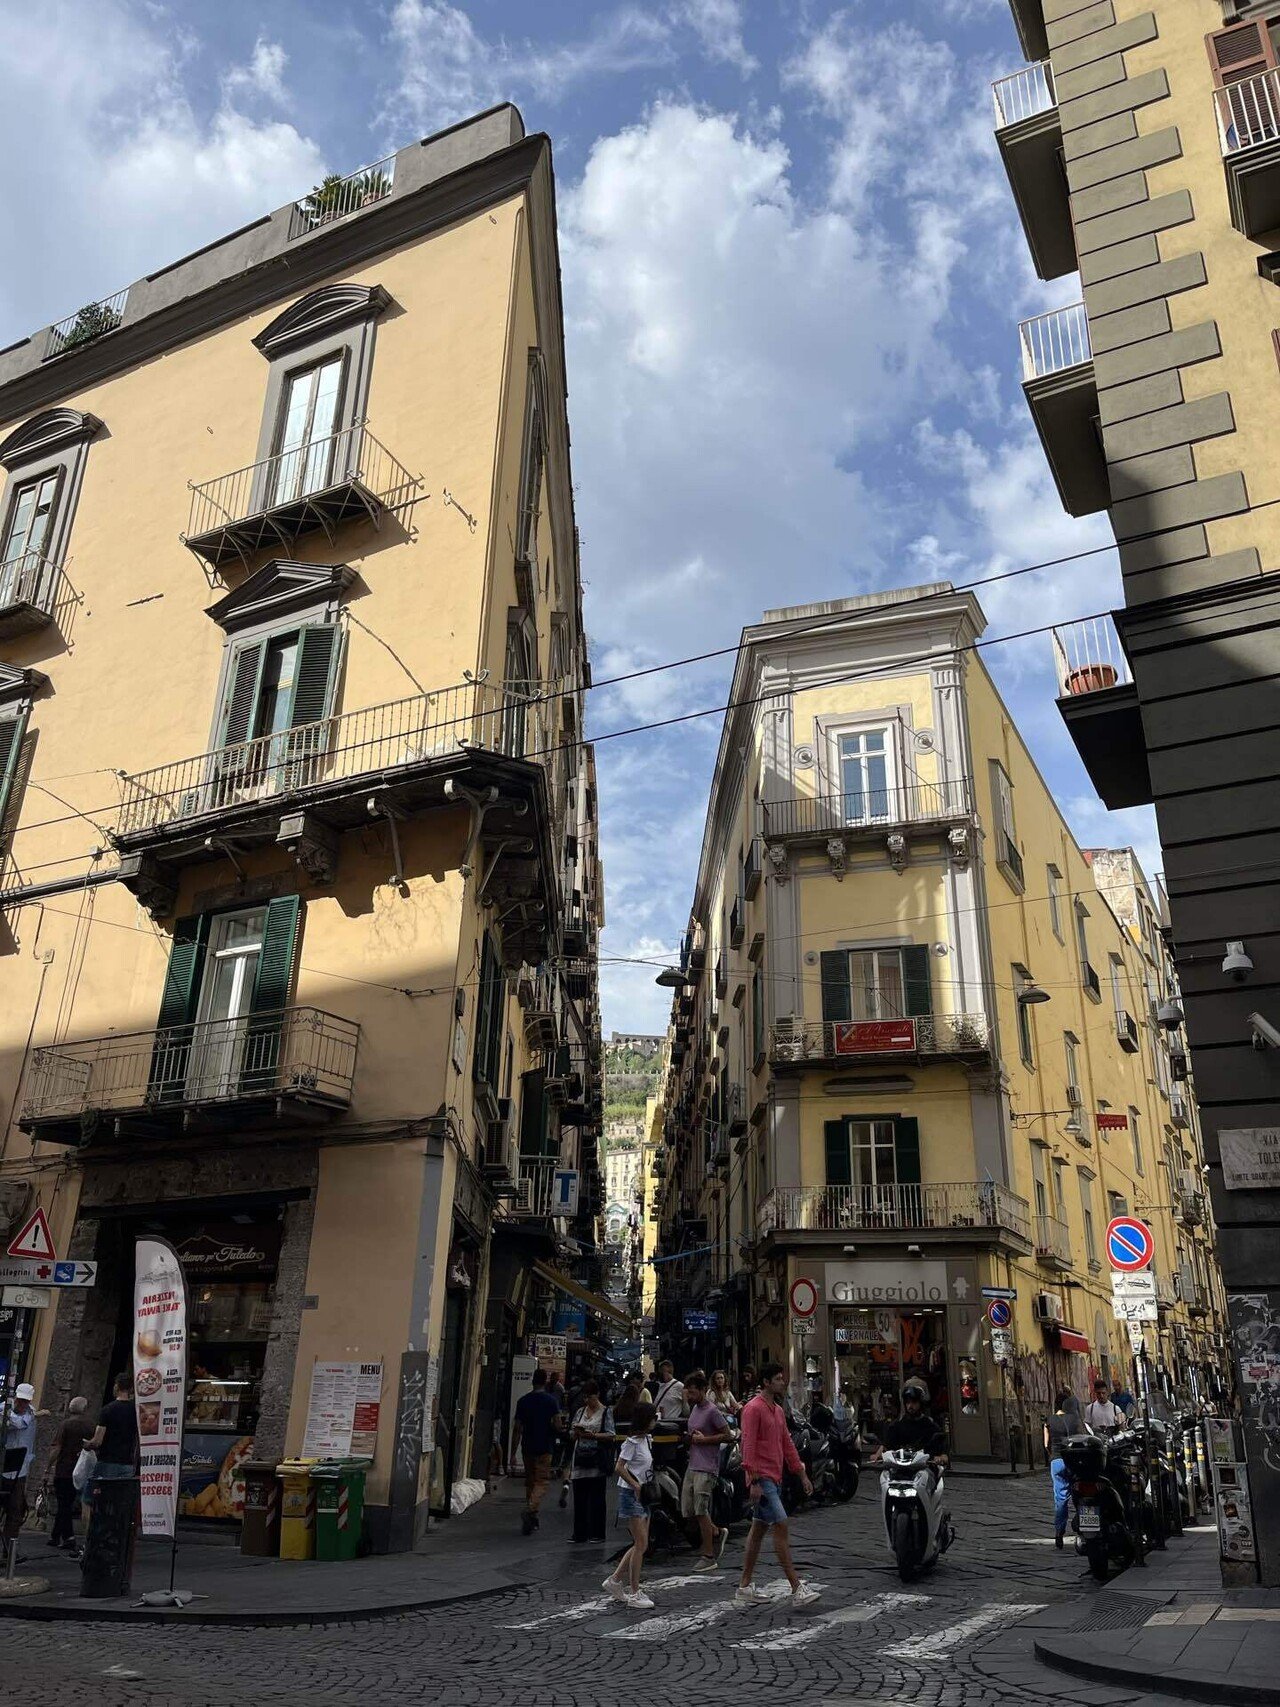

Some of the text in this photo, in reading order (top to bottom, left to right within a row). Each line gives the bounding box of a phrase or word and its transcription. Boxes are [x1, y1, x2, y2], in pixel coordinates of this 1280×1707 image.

[1264, 1134, 1279, 1145] VIA
[832, 1281, 942, 1302] Giuggiolo
[836, 1330, 880, 1341] INVERNALE
[360, 1364, 381, 1376] MENU
